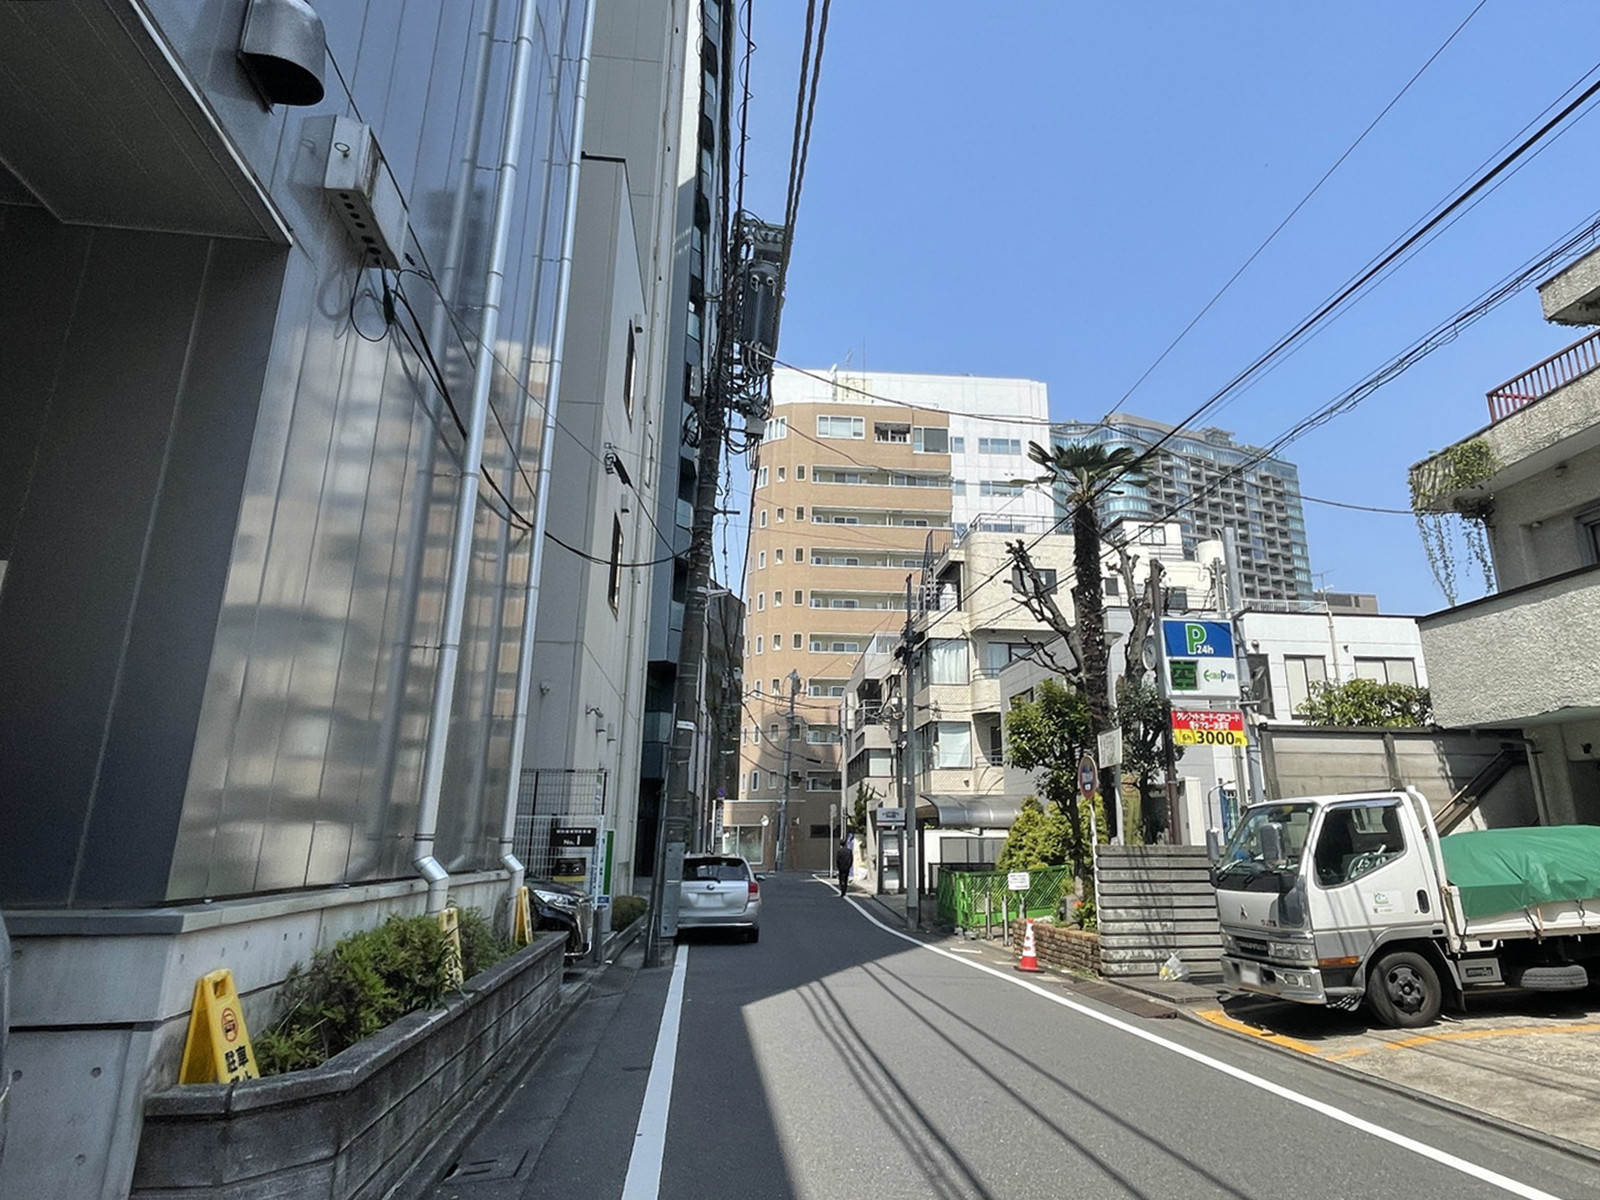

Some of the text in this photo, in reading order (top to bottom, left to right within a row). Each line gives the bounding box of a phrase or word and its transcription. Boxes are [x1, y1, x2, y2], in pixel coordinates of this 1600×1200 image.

[1185, 623, 1207, 655] P
[1196, 645, 1214, 654] 24h
[225, 1045, 249, 1073] 駐車
